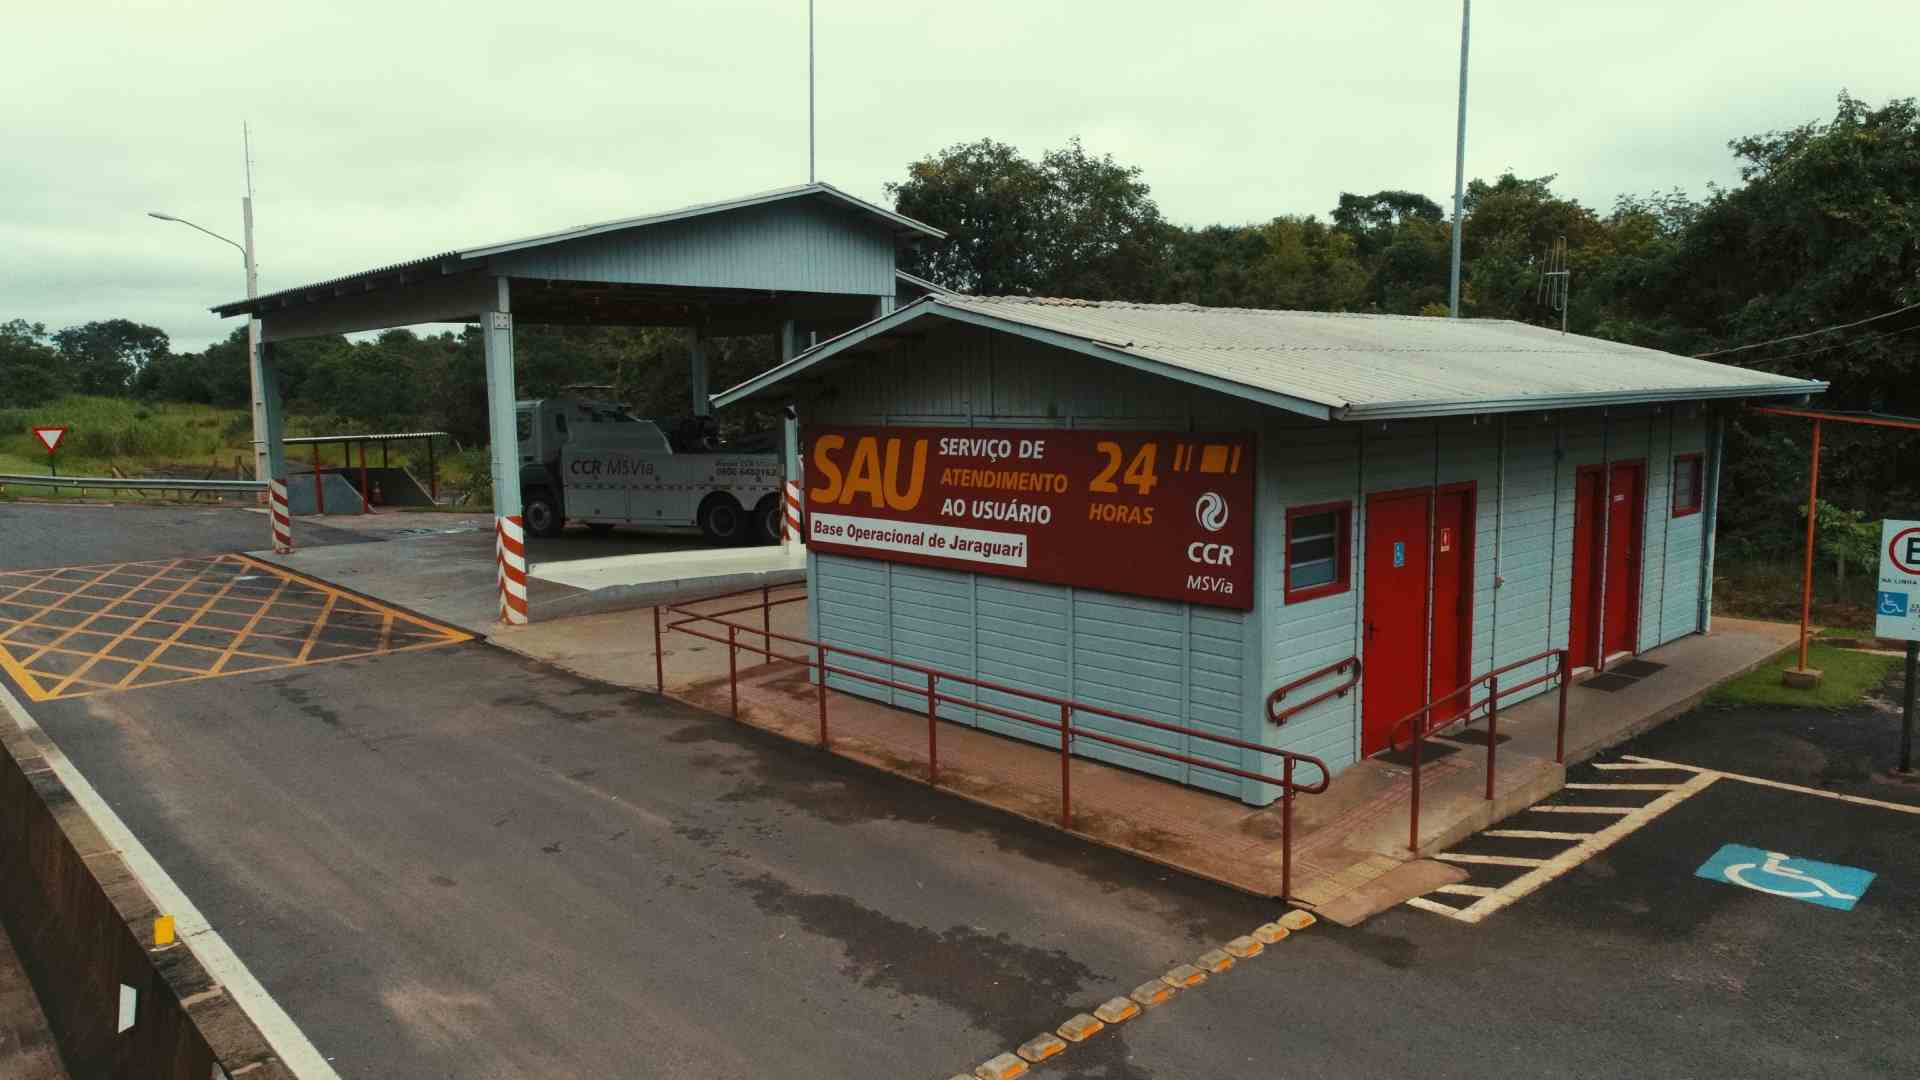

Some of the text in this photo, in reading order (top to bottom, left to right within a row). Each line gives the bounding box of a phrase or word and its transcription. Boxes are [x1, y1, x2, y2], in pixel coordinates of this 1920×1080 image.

[939, 437, 1045, 463] SERVIÇO DE
[571, 458, 602, 476] CCR
[810, 434, 928, 511] SAU
[1088, 440, 1159, 496] 24
[940, 468, 1068, 493] ATENDIMENTO
[941, 498, 1051, 525] AO USUÁRIO
[1088, 503, 1154, 525] HORAS
[813, 520, 1023, 558] Base Operacional de Jaraguari
[1187, 542, 1234, 566] CCR
[1186, 575, 1233, 594] MSVia
